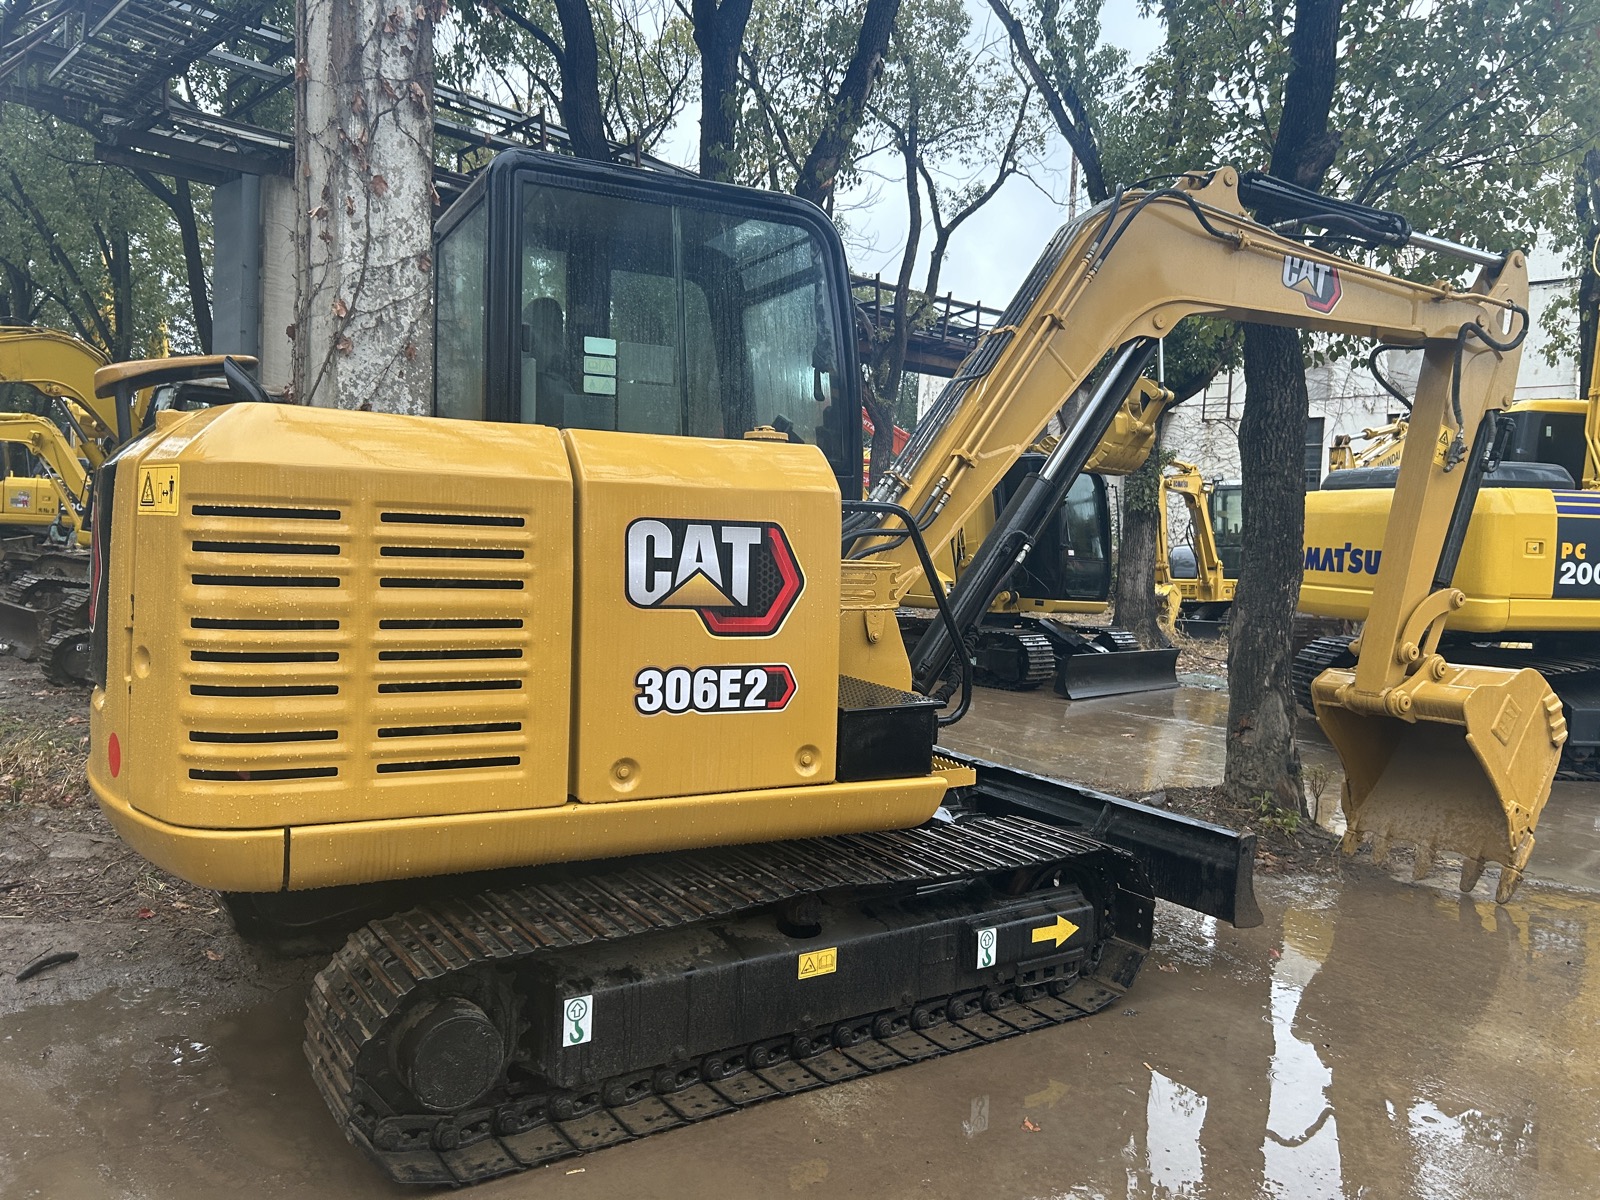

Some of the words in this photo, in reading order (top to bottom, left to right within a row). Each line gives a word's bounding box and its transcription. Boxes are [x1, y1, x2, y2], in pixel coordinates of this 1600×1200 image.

[1282, 255, 1331, 298] CAT
[627, 519, 762, 607] CAT
[1300, 542, 1383, 575] MATSU
[1561, 542, 1587, 560] PC
[637, 668, 768, 712] 306E2
